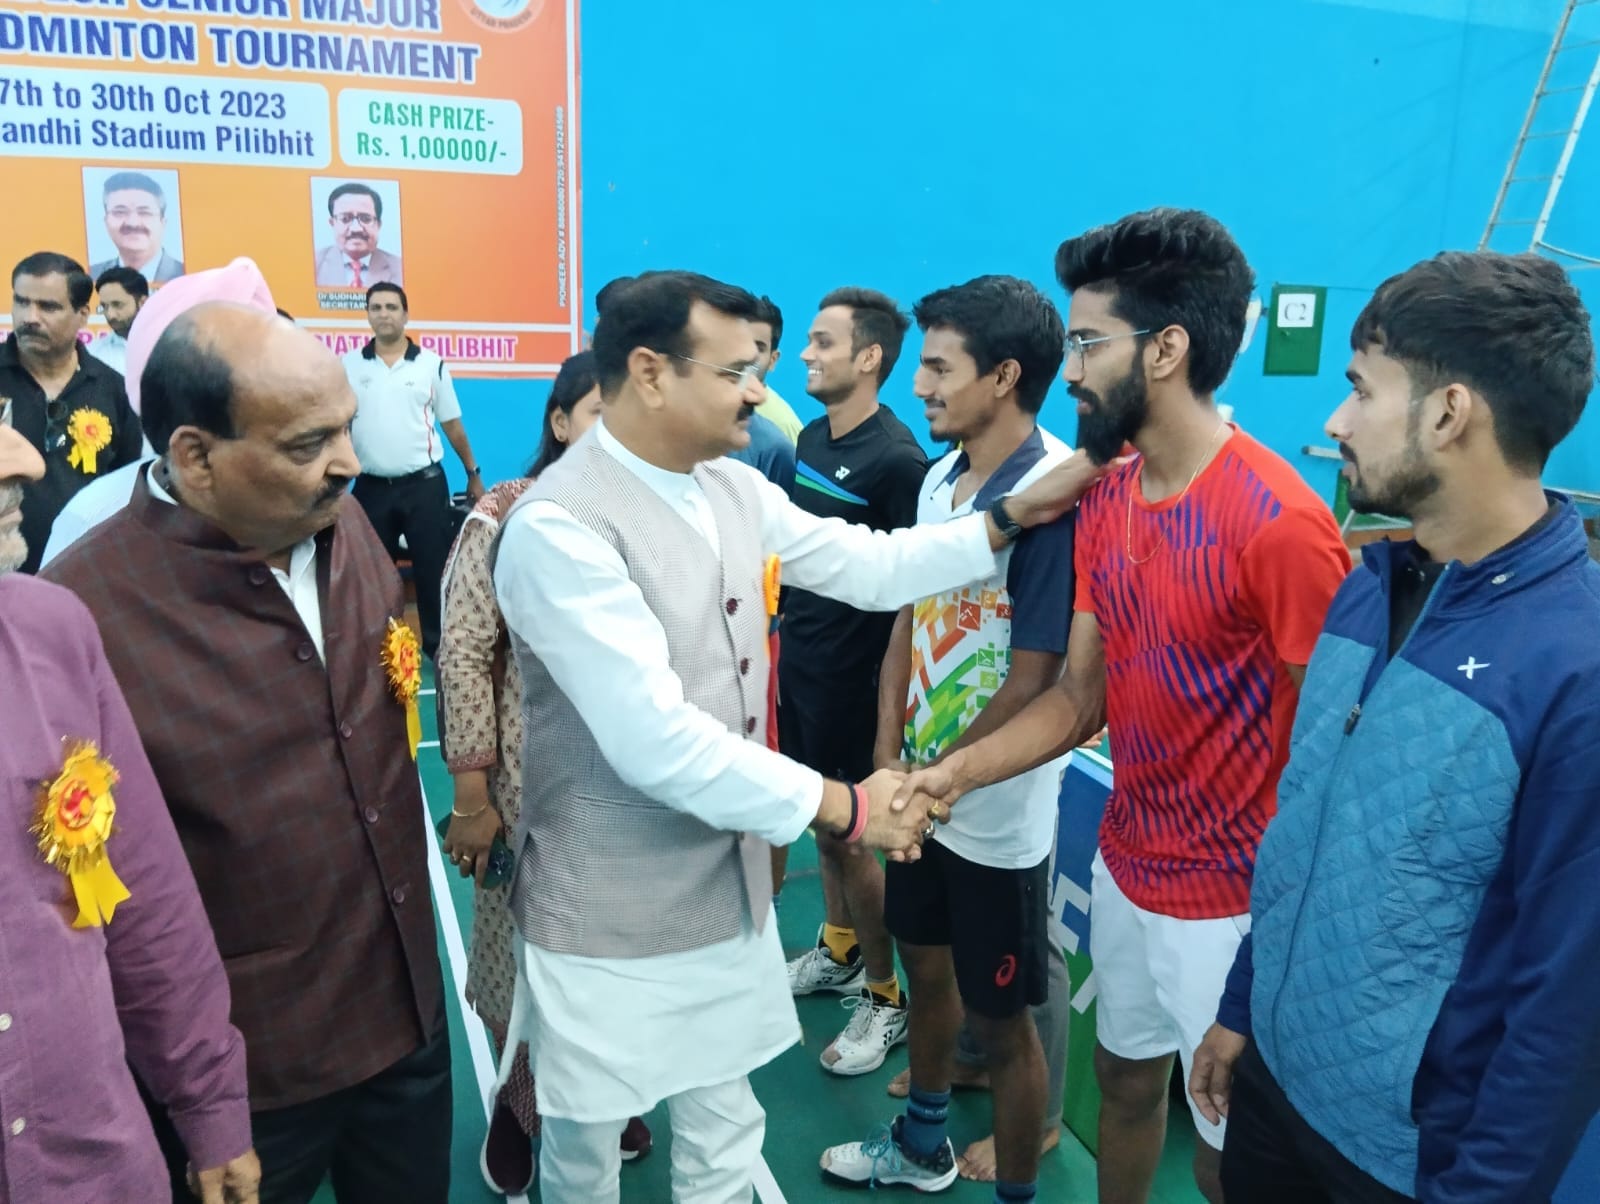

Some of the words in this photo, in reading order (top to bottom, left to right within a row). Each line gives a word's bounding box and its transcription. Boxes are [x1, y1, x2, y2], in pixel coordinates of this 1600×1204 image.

[303, 0, 439, 30] MAJOR
[210, 28, 478, 81] TOURNAMENT
[53, 82, 81, 108] to
[92, 83, 154, 112] 30th
[165, 87, 211, 115] Oct
[221, 90, 286, 119] 2023
[369, 101, 422, 127] CASH
[430, 105, 494, 131] PRIZE-
[92, 120, 206, 150] Stadium
[217, 126, 314, 157] Pilibhit
[357, 132, 390, 156] Rs.
[1284, 303, 1306, 320] C2
[421, 337, 517, 360] PILIBHIT
